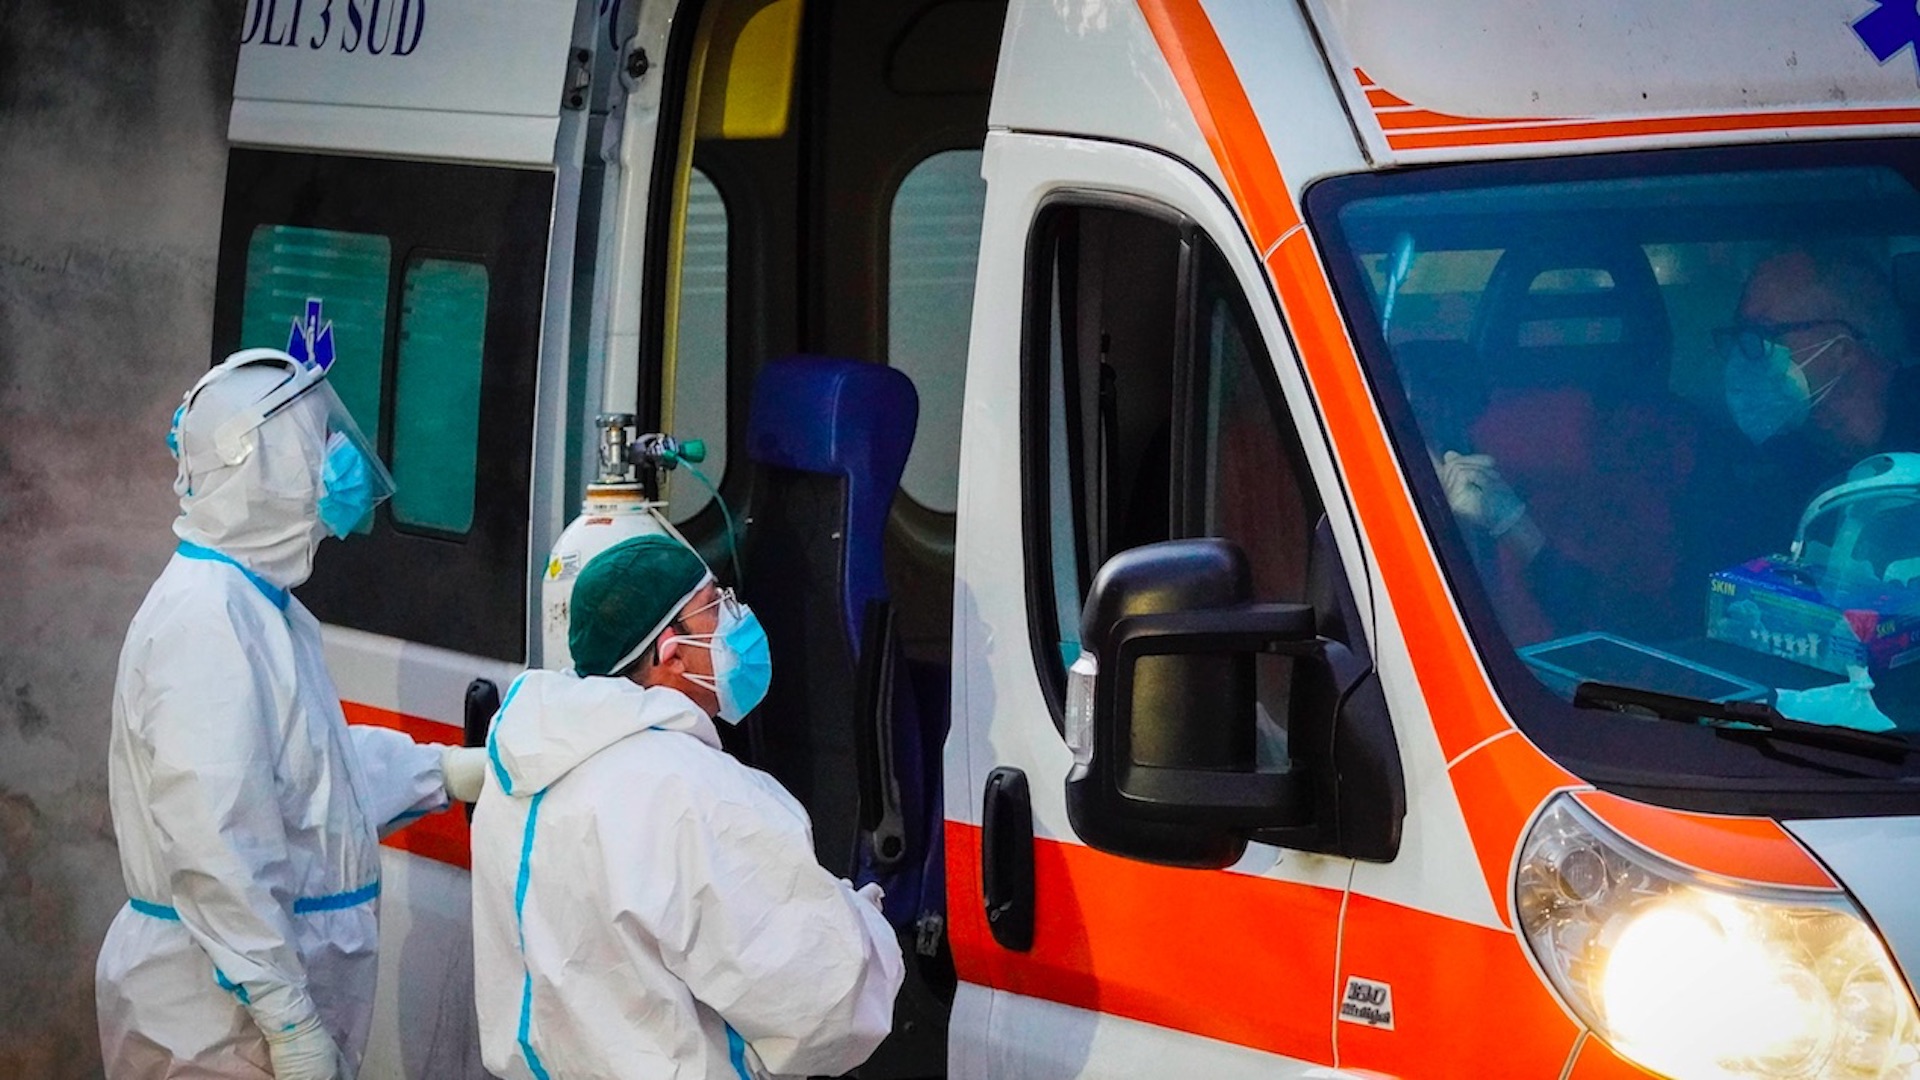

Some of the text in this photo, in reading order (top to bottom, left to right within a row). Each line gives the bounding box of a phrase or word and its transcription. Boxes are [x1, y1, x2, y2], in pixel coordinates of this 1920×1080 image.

[310, 0, 332, 49] 3
[341, 0, 425, 55] SUD
[1711, 579, 1736, 596] SKIN
